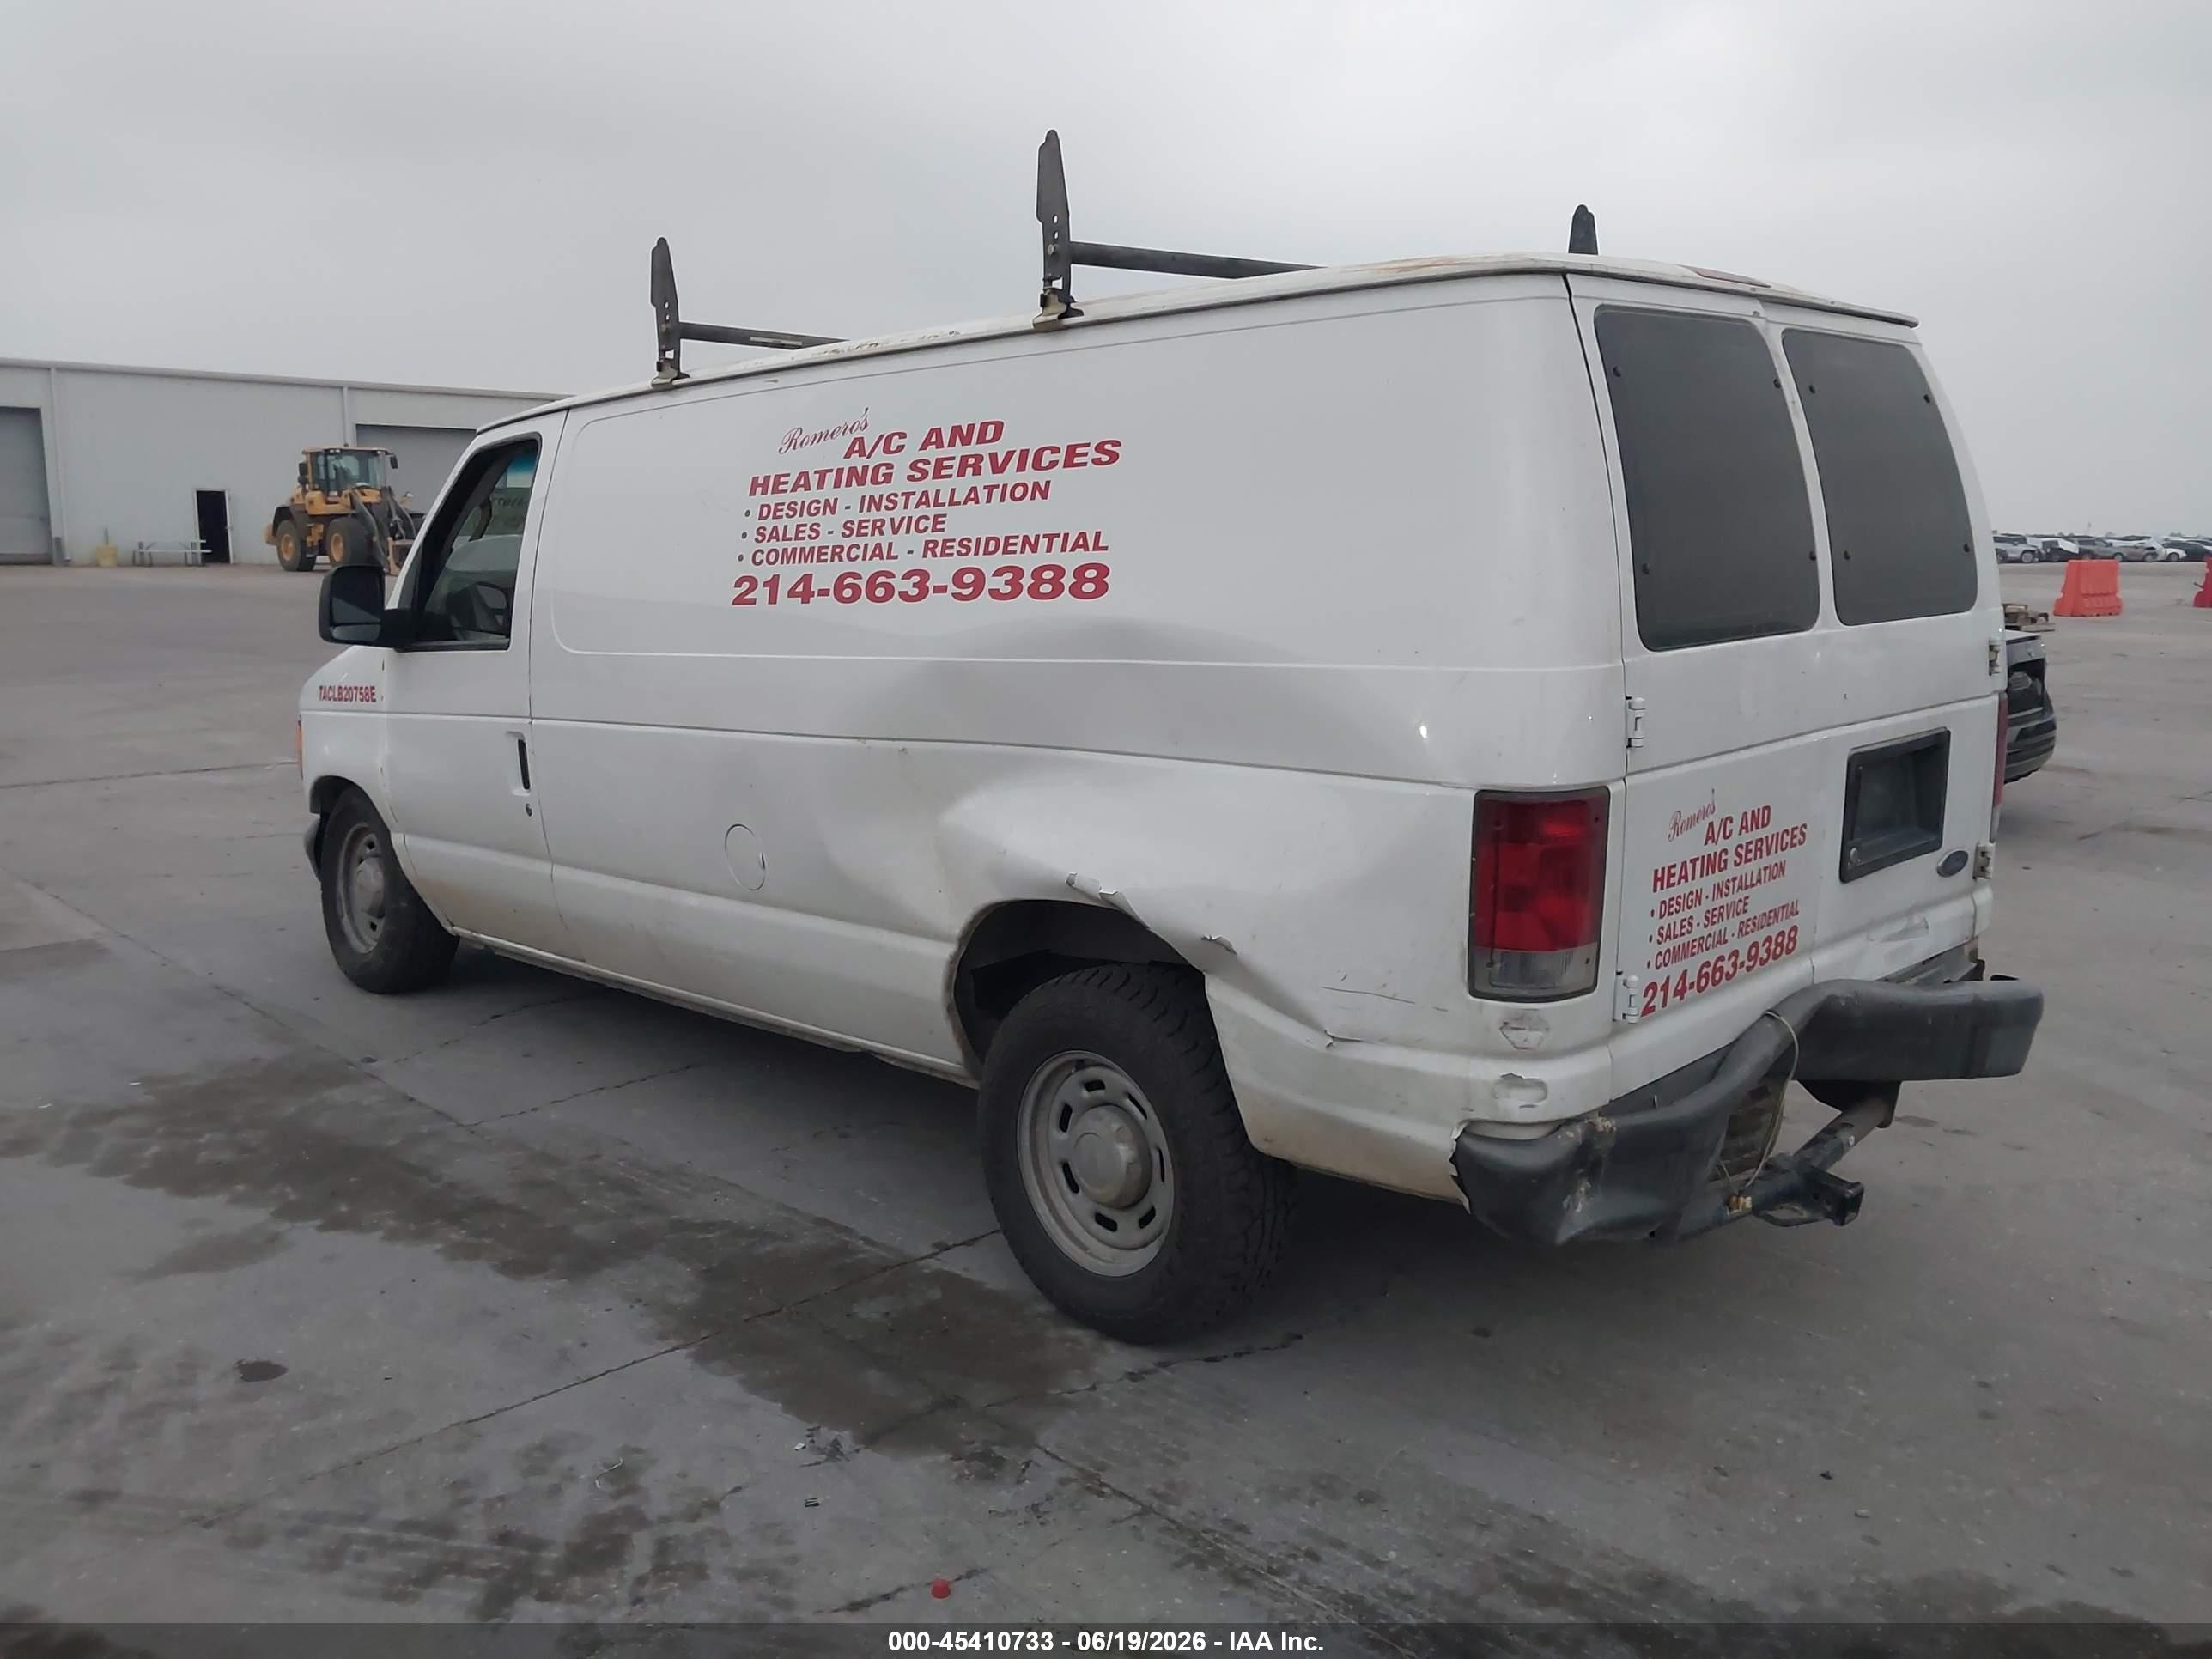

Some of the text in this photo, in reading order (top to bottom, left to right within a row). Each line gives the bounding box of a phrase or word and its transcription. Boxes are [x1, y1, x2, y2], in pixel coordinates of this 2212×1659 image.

[778, 408, 869, 454] Romero's
[843, 420, 1004, 459] A/C AND
[749, 439, 1122, 497] HEATING SERVICES
[757, 497, 838, 520] DESIGN
[859, 480, 1051, 514] INSTALLATION
[751, 539, 899, 567] COMMERCIAL
[922, 531, 1109, 559] RESIDENTIAL
[754, 522, 821, 544] SALES
[841, 514, 947, 539] SERVICE
[732, 562, 1110, 605] 214-663-9388
[319, 685, 377, 702] TACLB20758E
[1704, 805, 1771, 846] A/C AND
[1652, 823, 1808, 893] HEATING SERVICES
[1659, 888, 1703, 919] DESIGN
[1711, 860, 1786, 902] INSTALLATION
[1655, 927, 1729, 970] COMMERCIAL
[1737, 899, 1800, 939] RESIDENTIAL
[1656, 915, 1693, 945] SALES
[1704, 896, 1749, 929] SERVICE
[1640, 925, 1799, 1018] 214-663-9388
